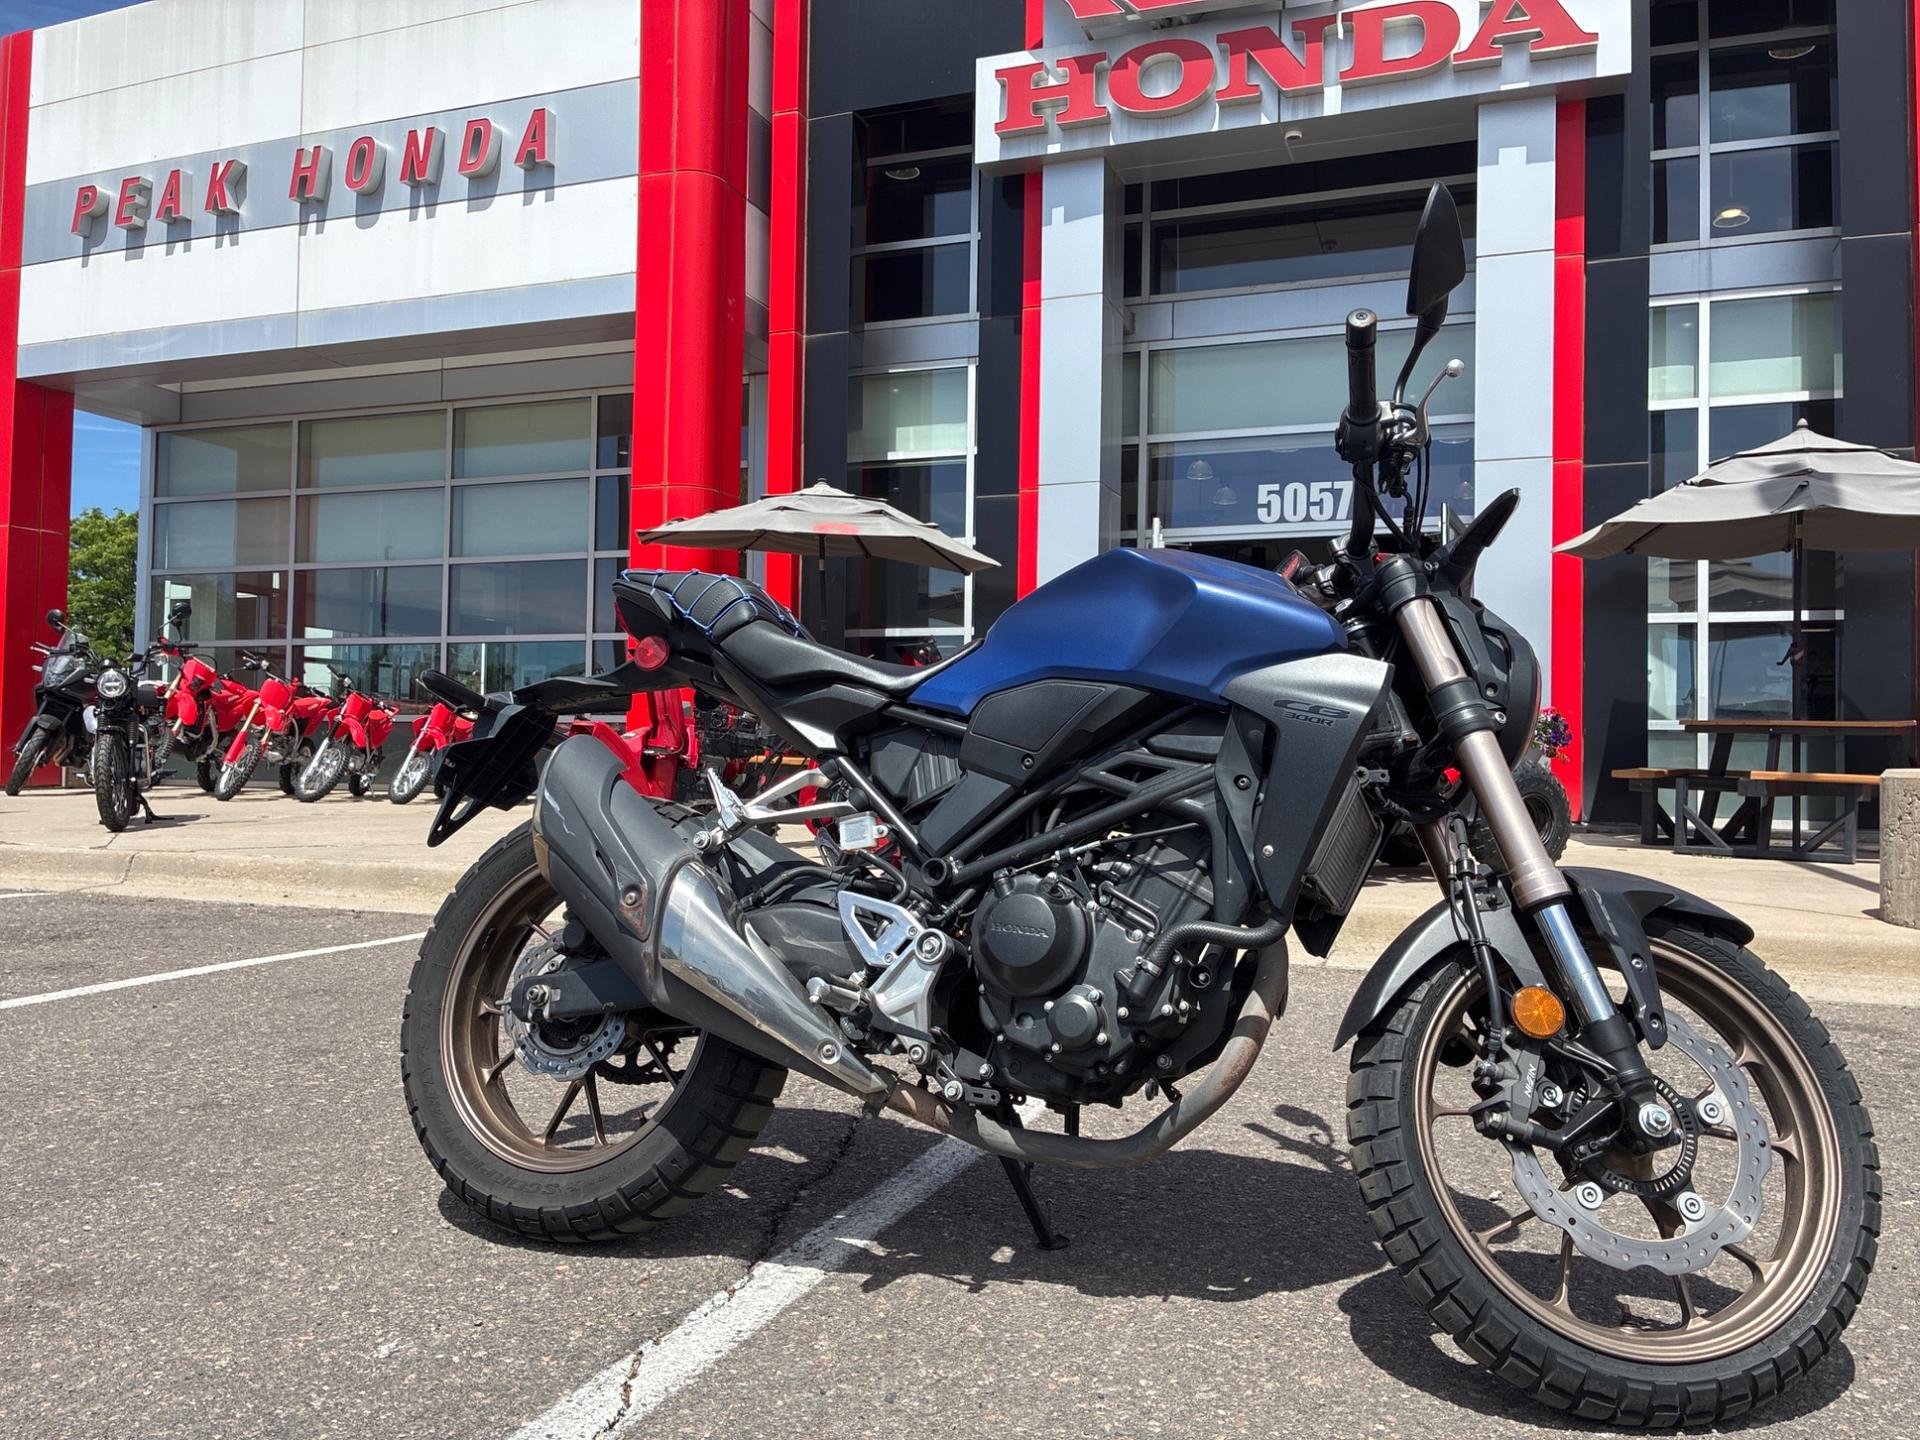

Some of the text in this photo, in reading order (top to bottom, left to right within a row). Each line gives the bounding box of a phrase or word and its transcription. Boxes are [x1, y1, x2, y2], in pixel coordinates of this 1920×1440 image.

[995, 0, 1599, 136] HONDA
[71, 107, 556, 236] PEAK HONDA
[1257, 480, 1353, 523] 5057
[1273, 699, 1350, 719] CB
[1284, 711, 1334, 727] 300R
[991, 921, 1049, 938] HONDA
